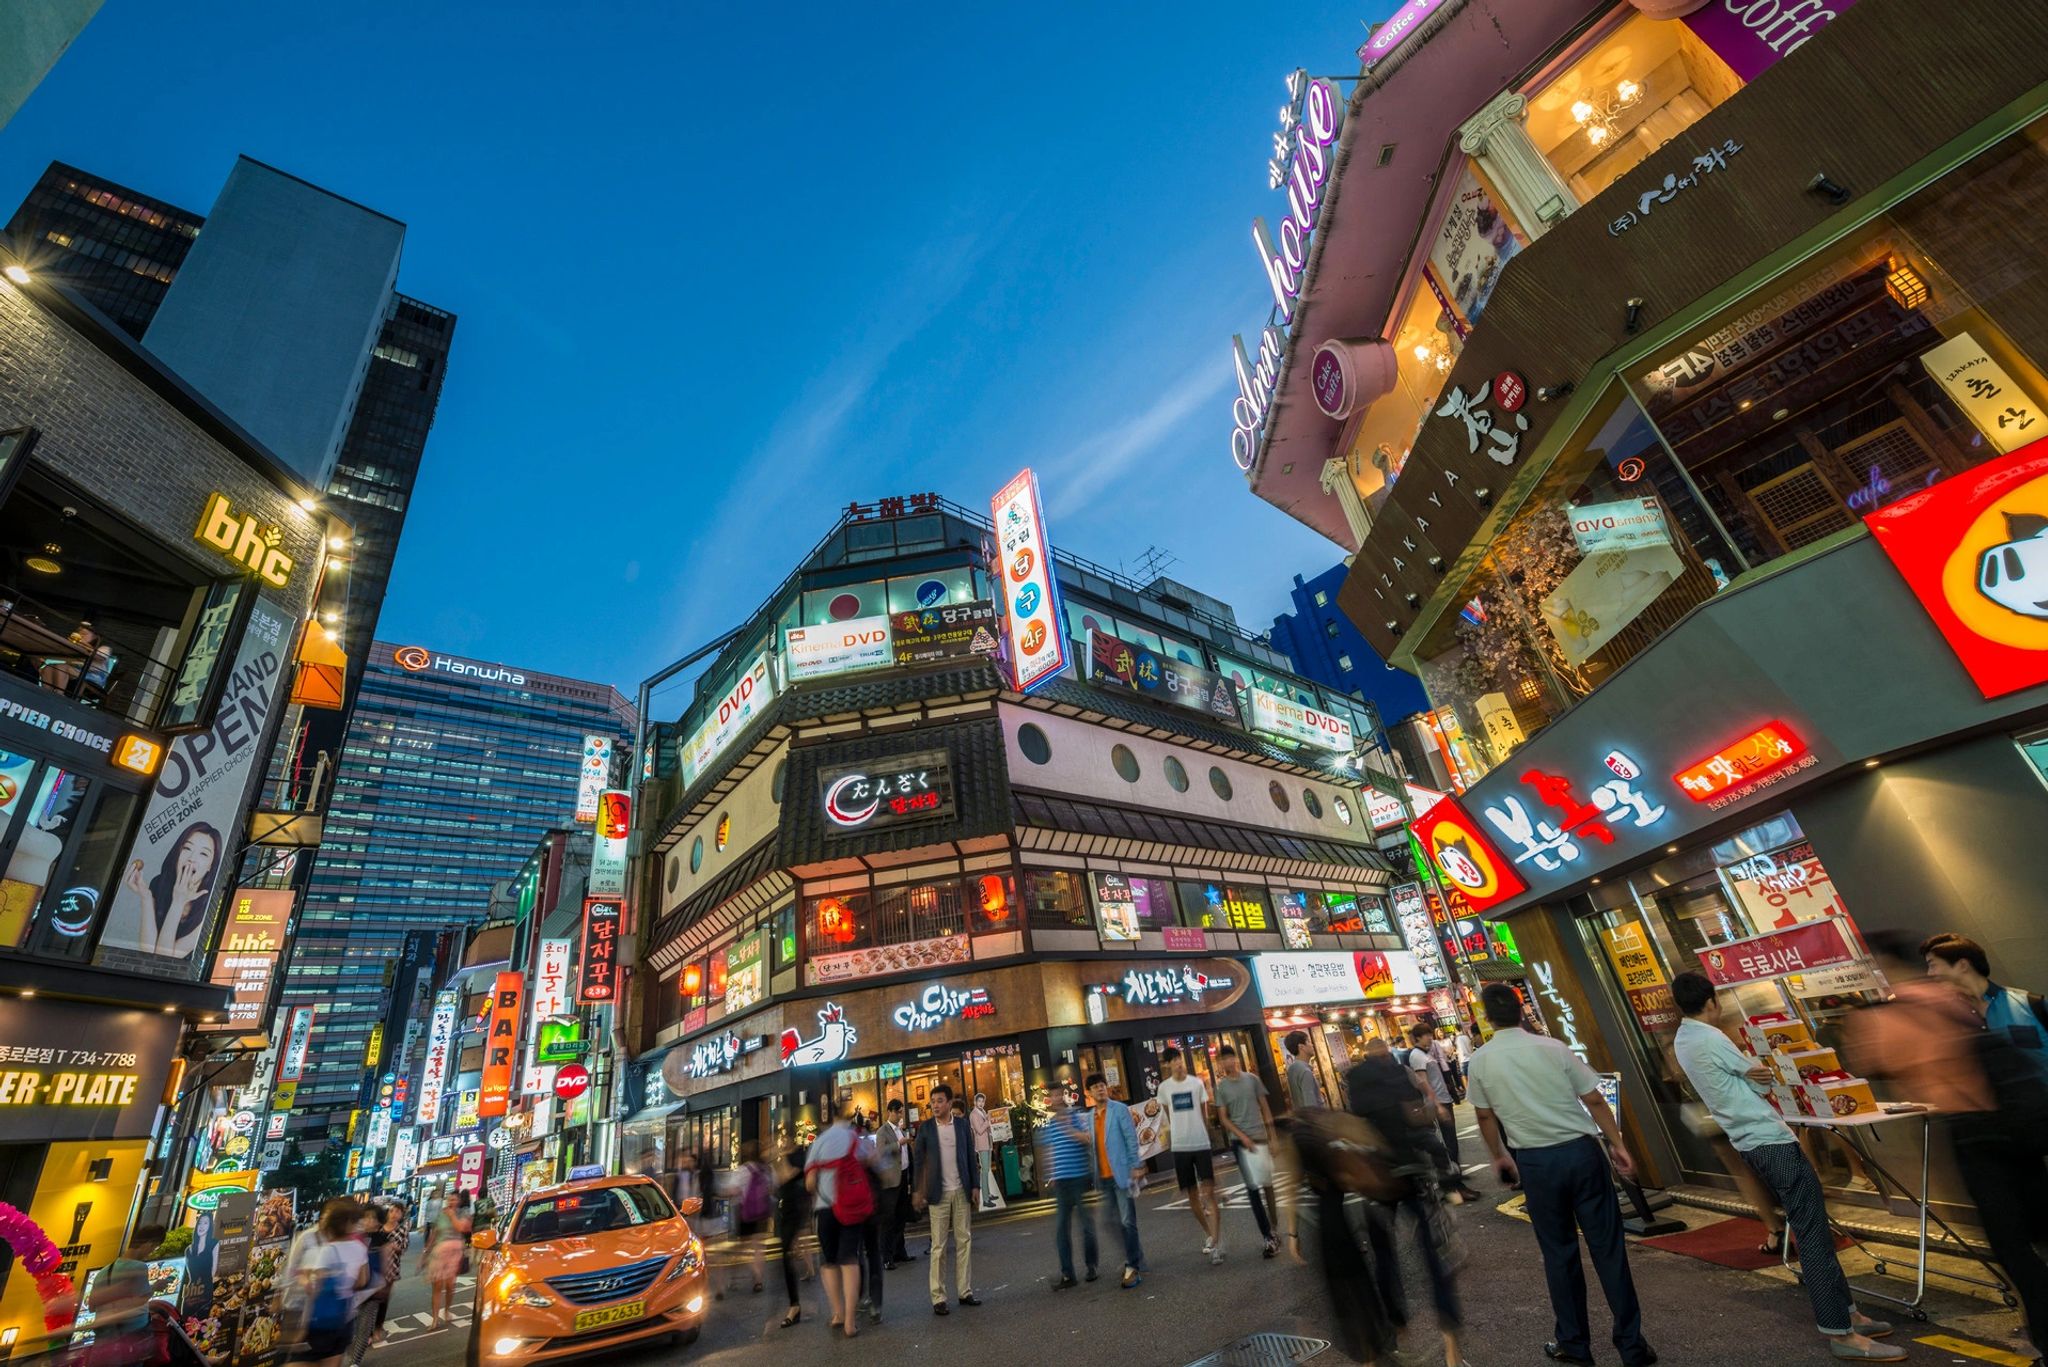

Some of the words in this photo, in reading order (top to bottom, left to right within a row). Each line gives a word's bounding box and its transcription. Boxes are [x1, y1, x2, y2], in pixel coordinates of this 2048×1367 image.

[1373, 12, 1415, 48] Coffee
[1254, 81, 1336, 318] house
[1317, 359, 1333, 390] Cake
[1323, 369, 1343, 406] Waffle
[1231, 335, 1281, 470] Ann
[196, 492, 296, 589] bhc
[843, 630, 886, 647] DVD
[1024, 628, 1043, 650] 4F
[434, 656, 526, 685] Hanwha
[719, 677, 753, 725] DVD
[1256, 693, 1303, 721] Kinema
[1306, 710, 1340, 734] DVD
[50, 719, 113, 754] CHOICE
[156, 685, 269, 800] OPEN
[144, 803, 179, 835] BETTER
[188, 769, 225, 799] HAPPIER
[224, 746, 255, 774] CHOICE
[149, 818, 178, 845] BEER
[178, 798, 204, 824] ZONE
[1369, 801, 1400, 817] DVD
[238, 904, 251, 914] 13
[1434, 905, 1476, 922] KIEMA
[228, 930, 275, 954] bhc
[223, 958, 272, 968] CHICKEN
[240, 970, 267, 980] BEER
[1269, 963, 1299, 981] 닭갈비
[1738, 946, 1806, 979] 무료시식
[235, 981, 265, 992] PLATE
[922, 984, 970, 1016] Chir
[489, 990, 518, 1067] BAR
[58, 1050, 67, 1064] T
[70, 1050, 137, 1068] 734-7788
[51, 1073, 138, 1105] PLATE
[556, 1076, 588, 1088] DVD
